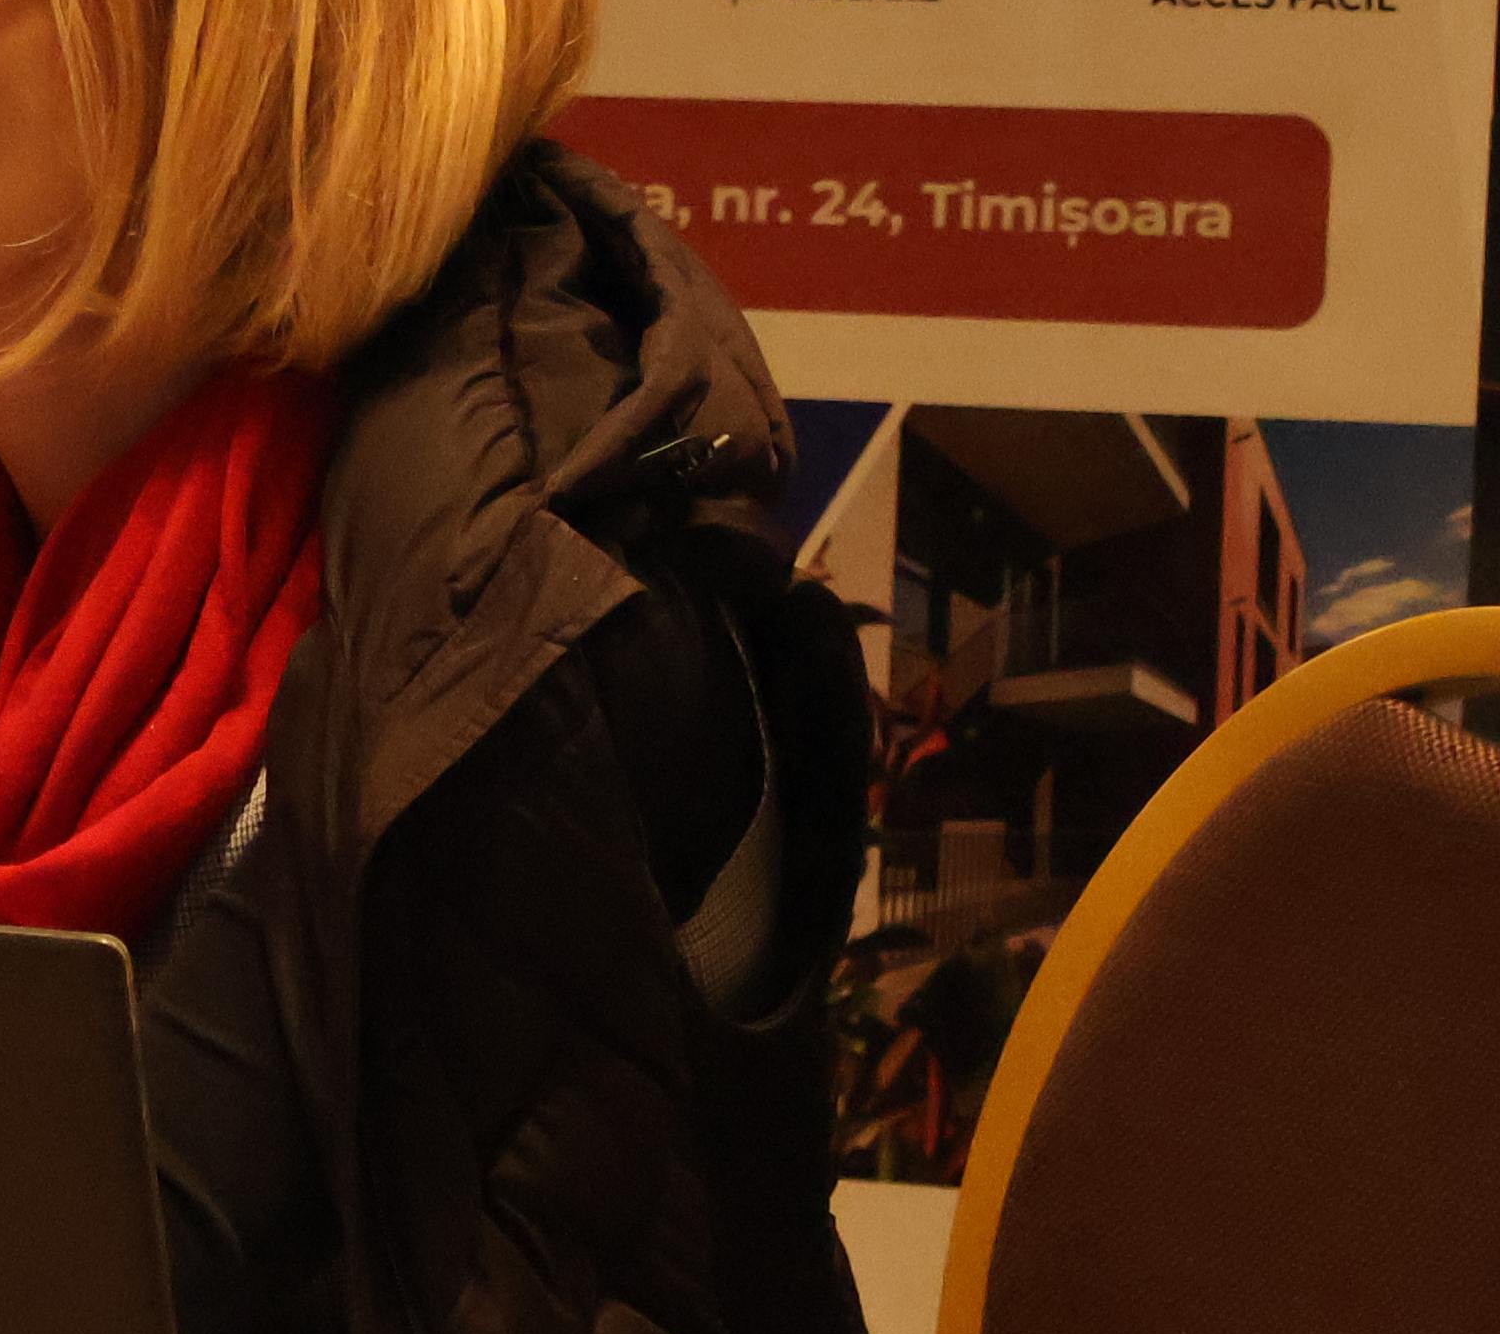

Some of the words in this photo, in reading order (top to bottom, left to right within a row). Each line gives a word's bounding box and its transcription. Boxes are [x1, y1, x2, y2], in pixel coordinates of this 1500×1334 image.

[710, 184, 794, 225] nr.
[810, 178, 903, 238] 24,
[920, 178, 1233, 249] Timișoara
